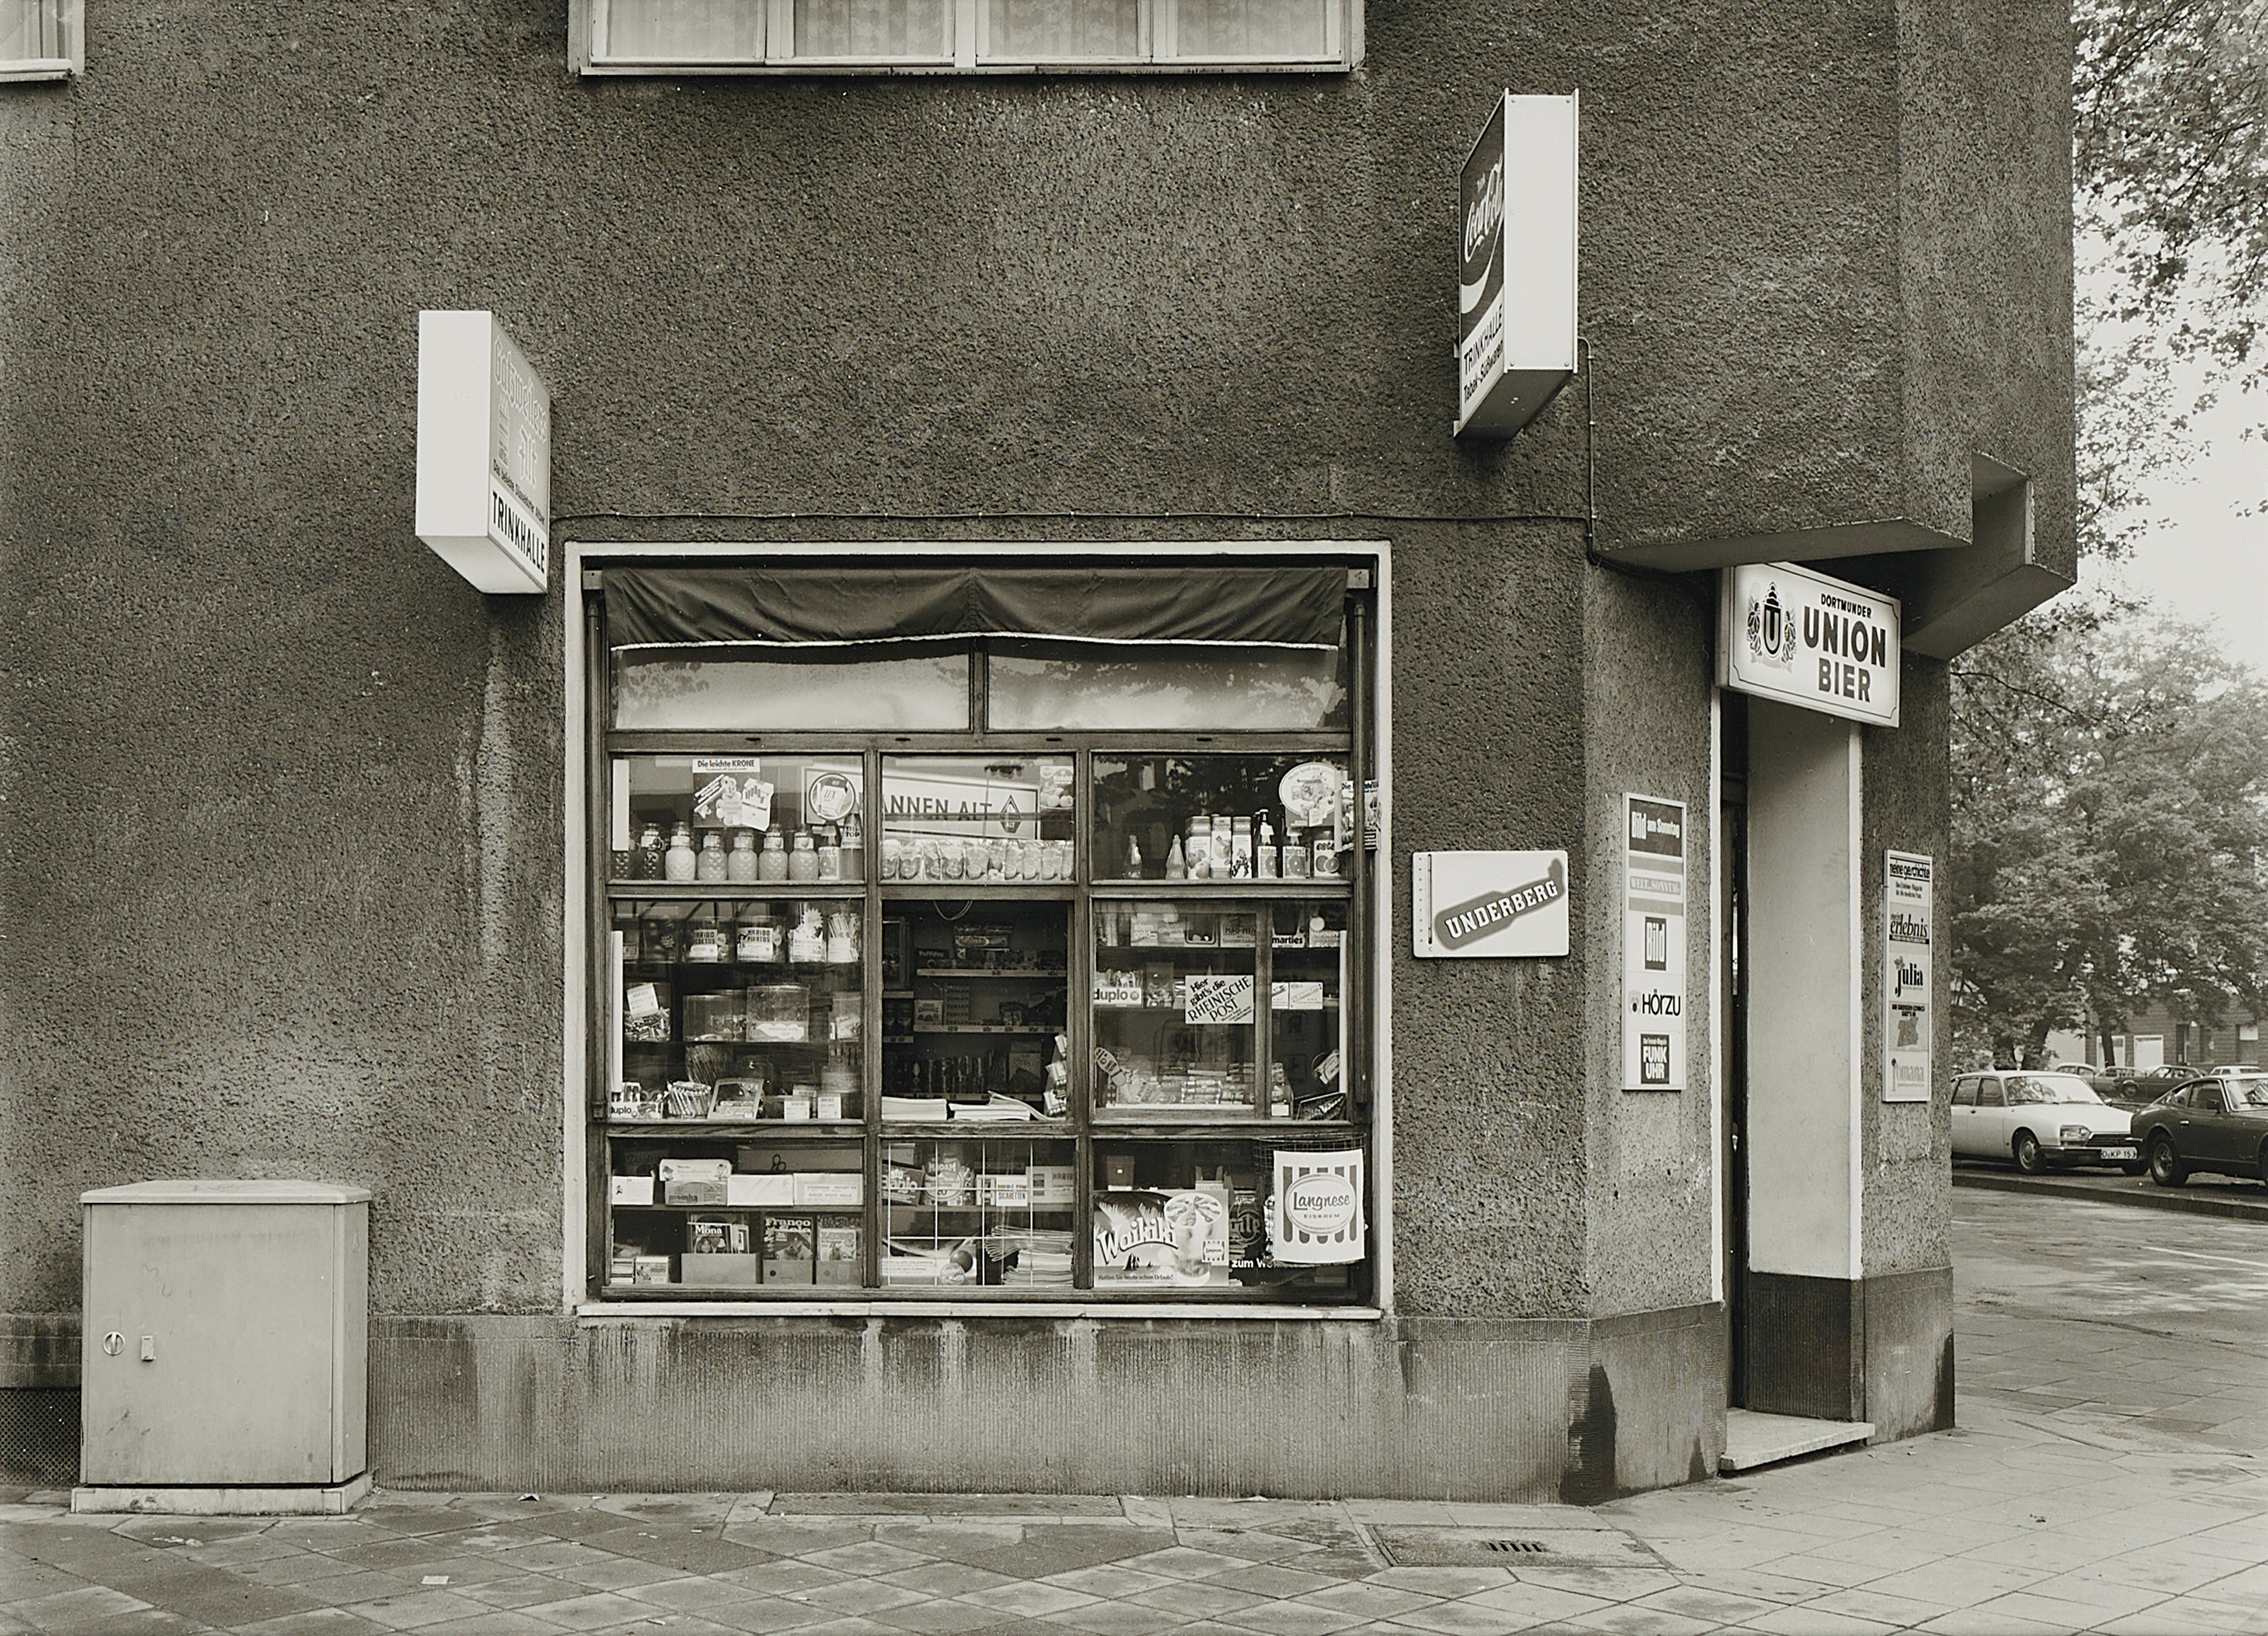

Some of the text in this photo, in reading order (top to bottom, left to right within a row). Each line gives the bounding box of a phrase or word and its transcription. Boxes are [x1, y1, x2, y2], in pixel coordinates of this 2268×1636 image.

[1464, 303, 1503, 376] TRINKHALLE
[492, 490, 545, 574] TRINKHALLE
[1821, 593, 1872, 619] DORTMUNDER
[1804, 605, 1886, 668] UNION
[1819, 657, 1871, 703] BIER
[1631, 811, 1680, 839] Bild am Sonntag
[1630, 877, 1680, 894] WELT SONNTAG
[1445, 880, 1558, 939] UNDERBERG
[1890, 914, 1928, 939] erlebnis
[1646, 922, 1665, 963] Bild
[1093, 988, 1128, 1003] duplo
[1190, 978, 1209, 993] Hier
[1212, 980, 1225, 991] die
[1187, 976, 1251, 1022] RHEINISCHE
[1209, 998, 1238, 1022] POST
[1643, 1046, 1667, 1064] FUNK
[1646, 1063, 1665, 1080] UHR
[1293, 1191, 1350, 1211] Langnese
[695, 1224, 723, 1235] Mona
[1096, 1217, 1179, 1265] Waikiki
[1231, 1259, 1254, 1268] zum
